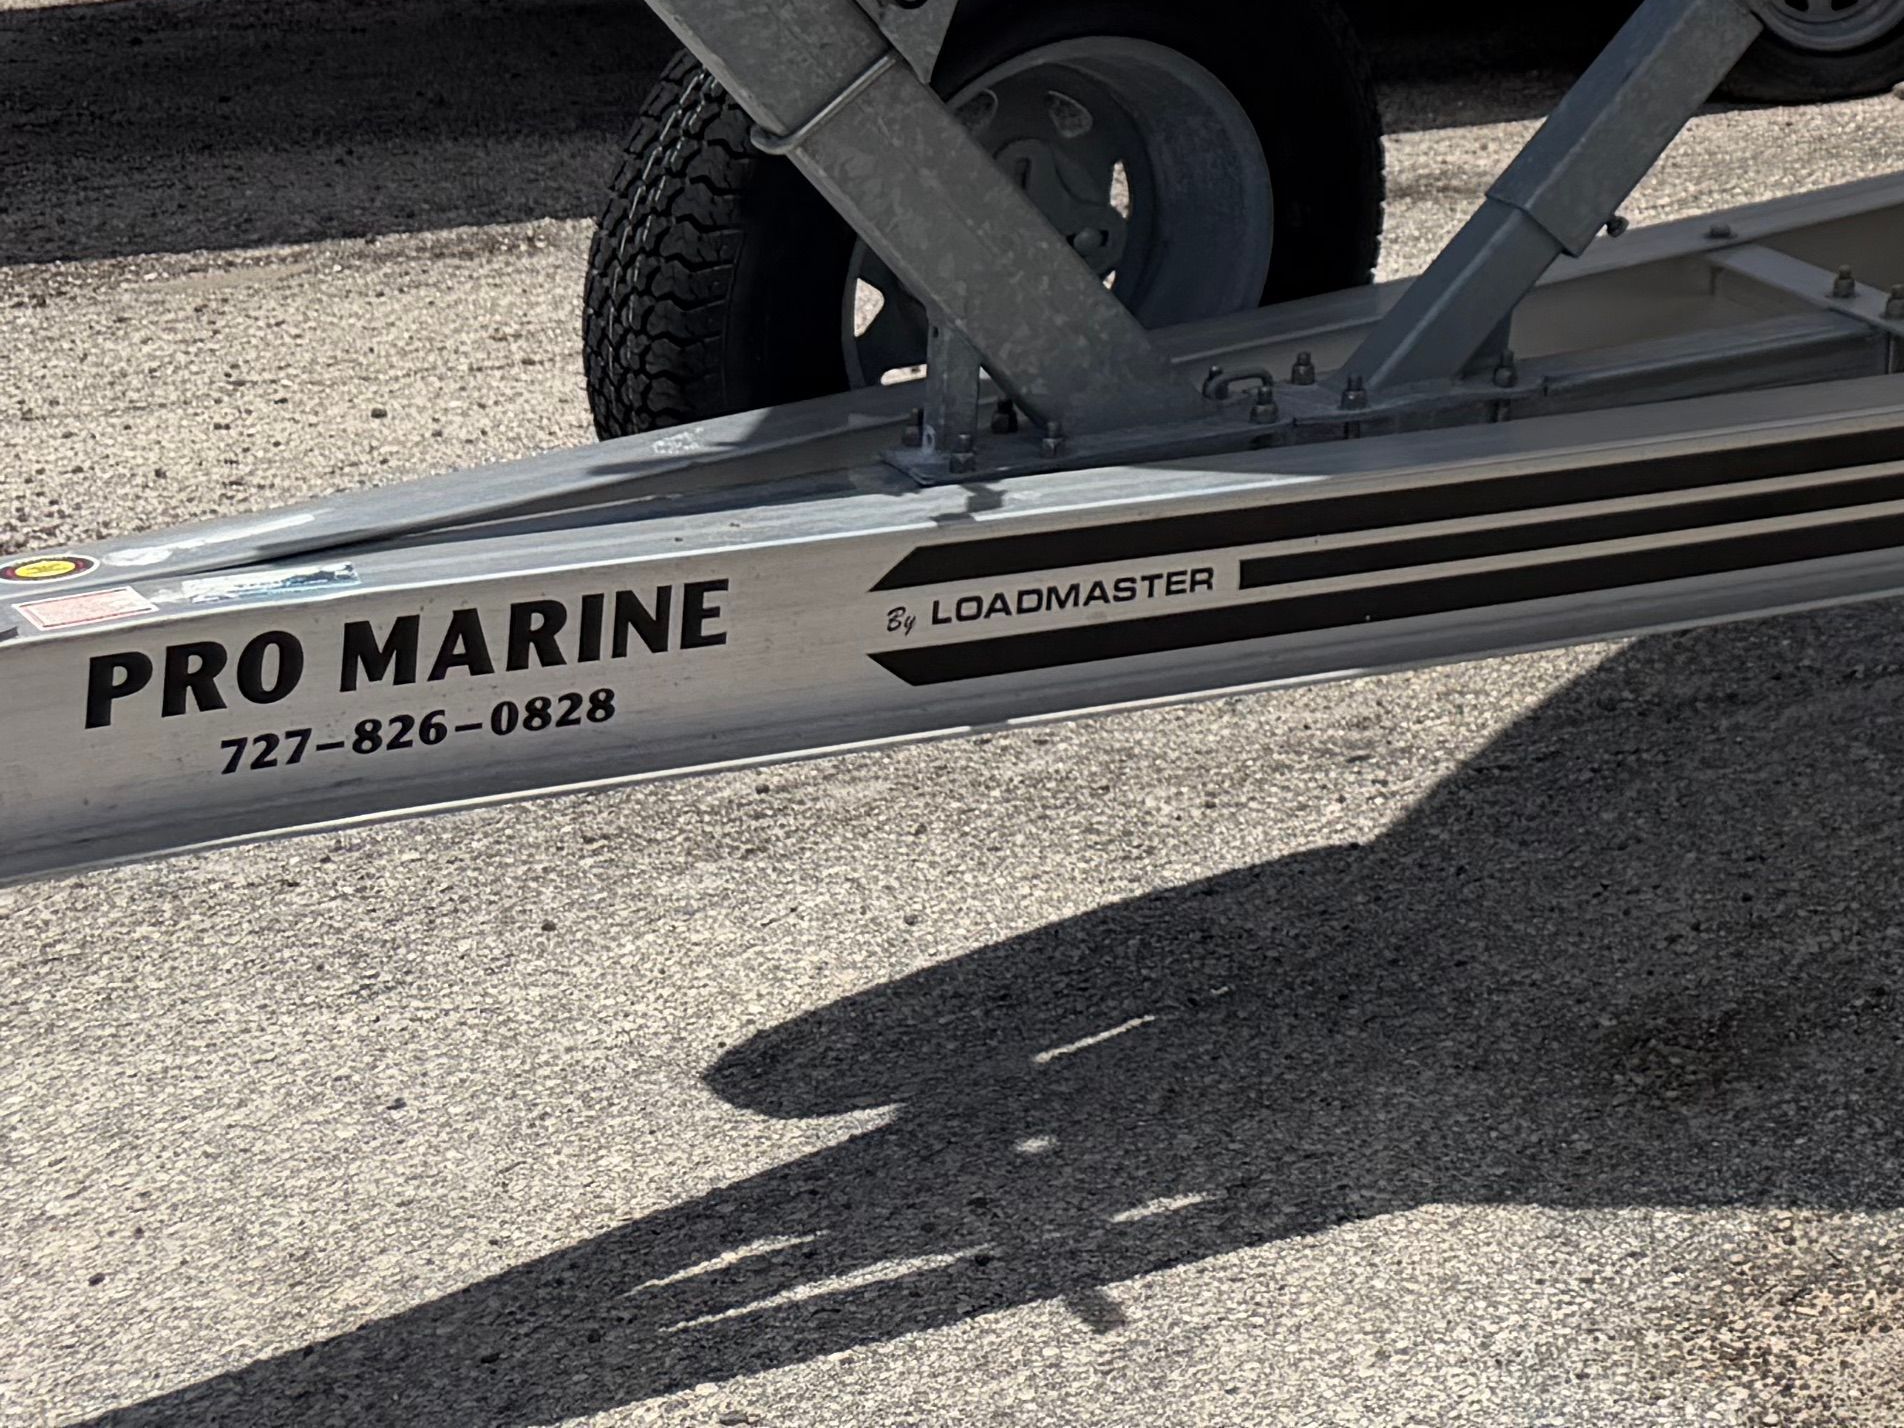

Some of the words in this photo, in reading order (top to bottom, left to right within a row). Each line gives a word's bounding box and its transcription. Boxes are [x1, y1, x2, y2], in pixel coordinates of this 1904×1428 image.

[885, 606, 917, 636] By
[931, 567, 1214, 627] LOADMASTER
[85, 630, 305, 729] PRO
[339, 578, 730, 693] MARINE
[219, 687, 617, 775] 727-826-0828
